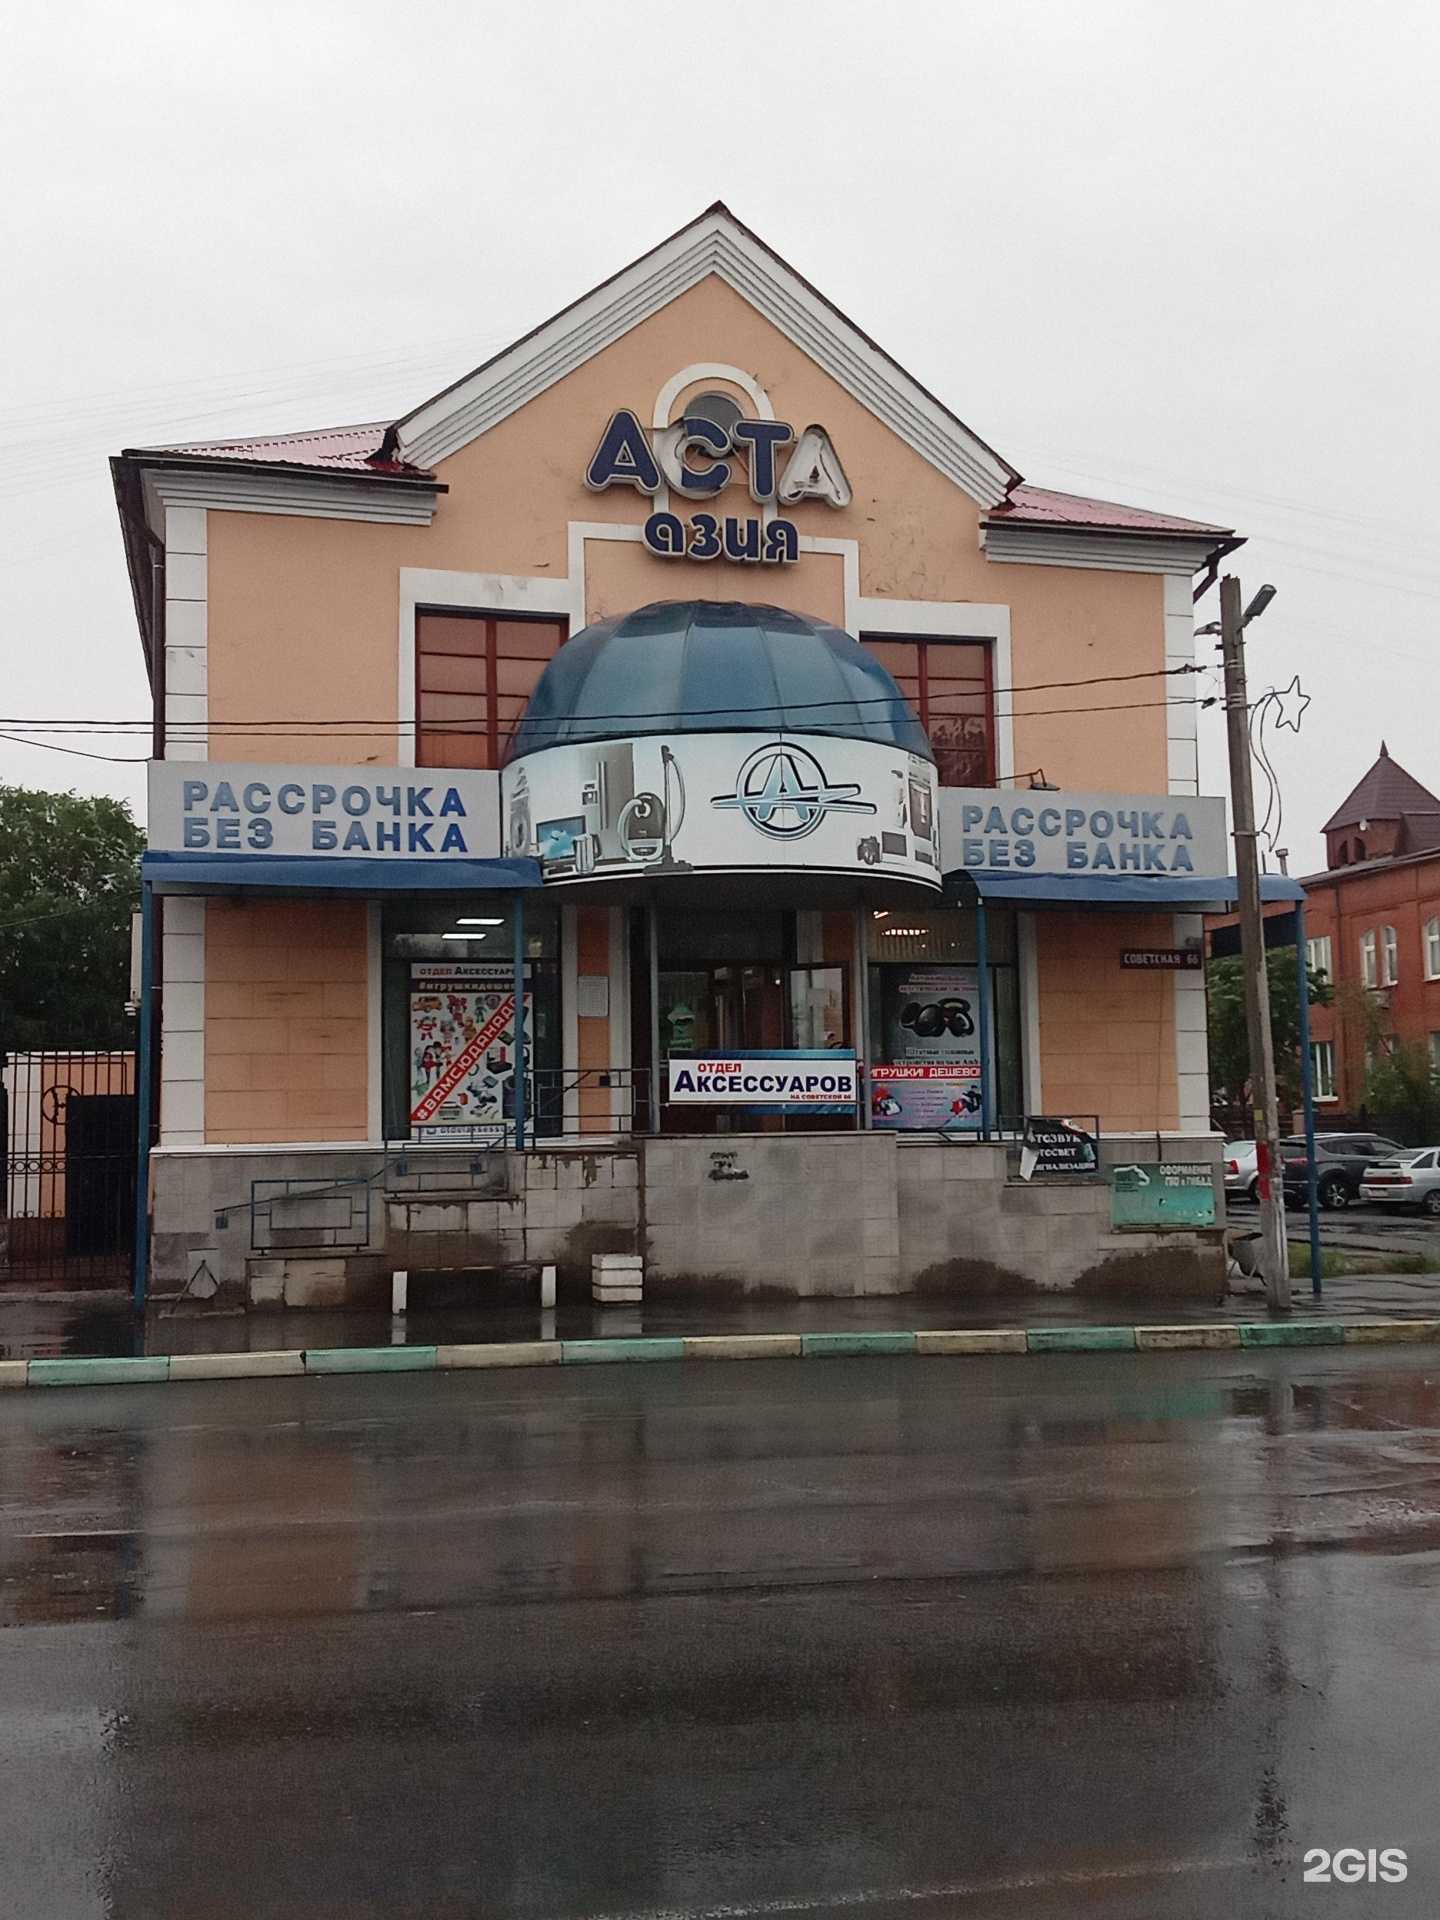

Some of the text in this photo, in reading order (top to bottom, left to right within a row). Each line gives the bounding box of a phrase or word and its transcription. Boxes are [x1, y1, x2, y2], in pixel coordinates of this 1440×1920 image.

[584, 408, 853, 509] АСТА
[642, 512, 800, 564] азия
[183, 781, 467, 817] РАССРОЧКА
[183, 817, 469, 853] БЕЗ БАНКА
[962, 805, 1194, 840] РАССРОЧКА
[963, 838, 1194, 872] БЕЗ БАНКА
[454, 966, 516, 976] АКСЕССУАР
[1124, 953, 1180, 964] СОВЕТСКАЯ
[673, 1070, 853, 1093] АКСЕССУАРОВ
[698, 1063, 742, 1074] ОТДЕЛ
[1033, 1133, 1081, 1143] ТОЗВУК
[1039, 1147, 1077, 1157] ТОСВЕТ
